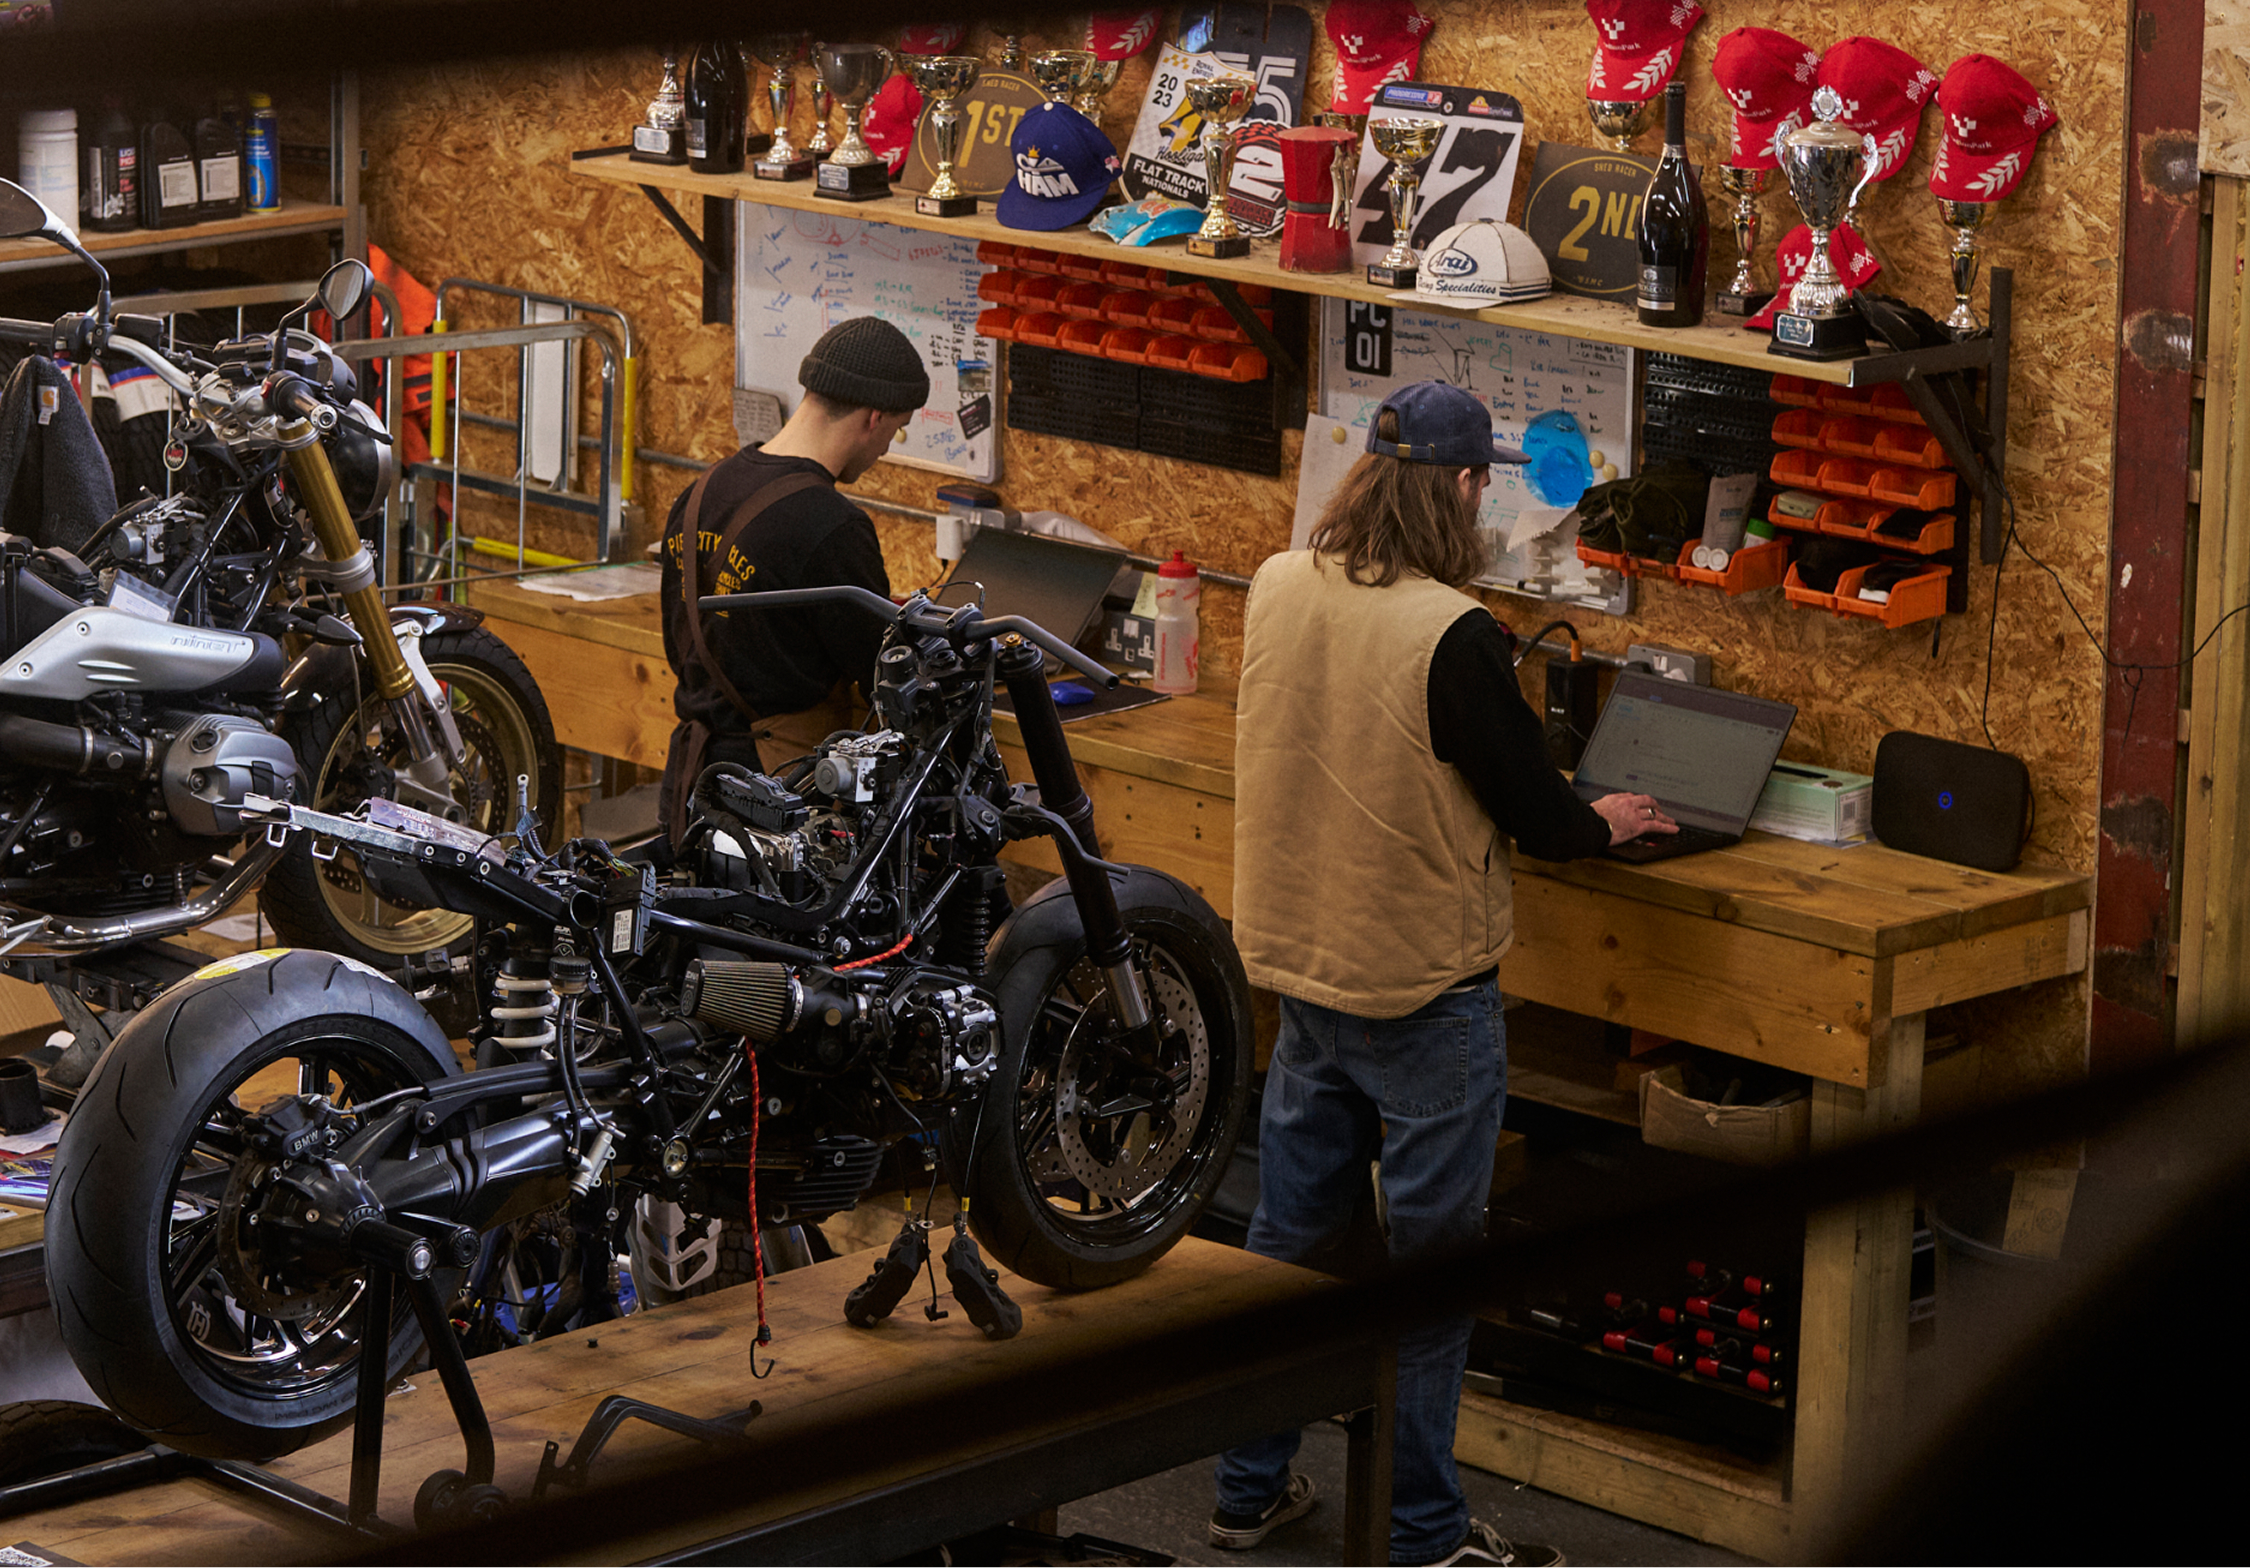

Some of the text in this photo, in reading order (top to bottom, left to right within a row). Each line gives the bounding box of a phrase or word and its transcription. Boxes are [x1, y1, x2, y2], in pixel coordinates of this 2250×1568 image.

[1158, 73, 1178, 91] 20
[1152, 90, 1173, 108] 23
[958, 100, 1026, 168] 1ST
[1133, 158, 1206, 194] FLAT TRACK
[1594, 163, 1636, 178] SHED RACER
[1017, 168, 1080, 198] HAM
[1141, 175, 1190, 199] NATIONALS
[1356, 124, 1516, 251] 47
[1430, 250, 1470, 271] Arai
[1436, 280, 1497, 295] Specialities
[668, 533, 683, 557] PIE
[294, 1130, 319, 1151] BMW
